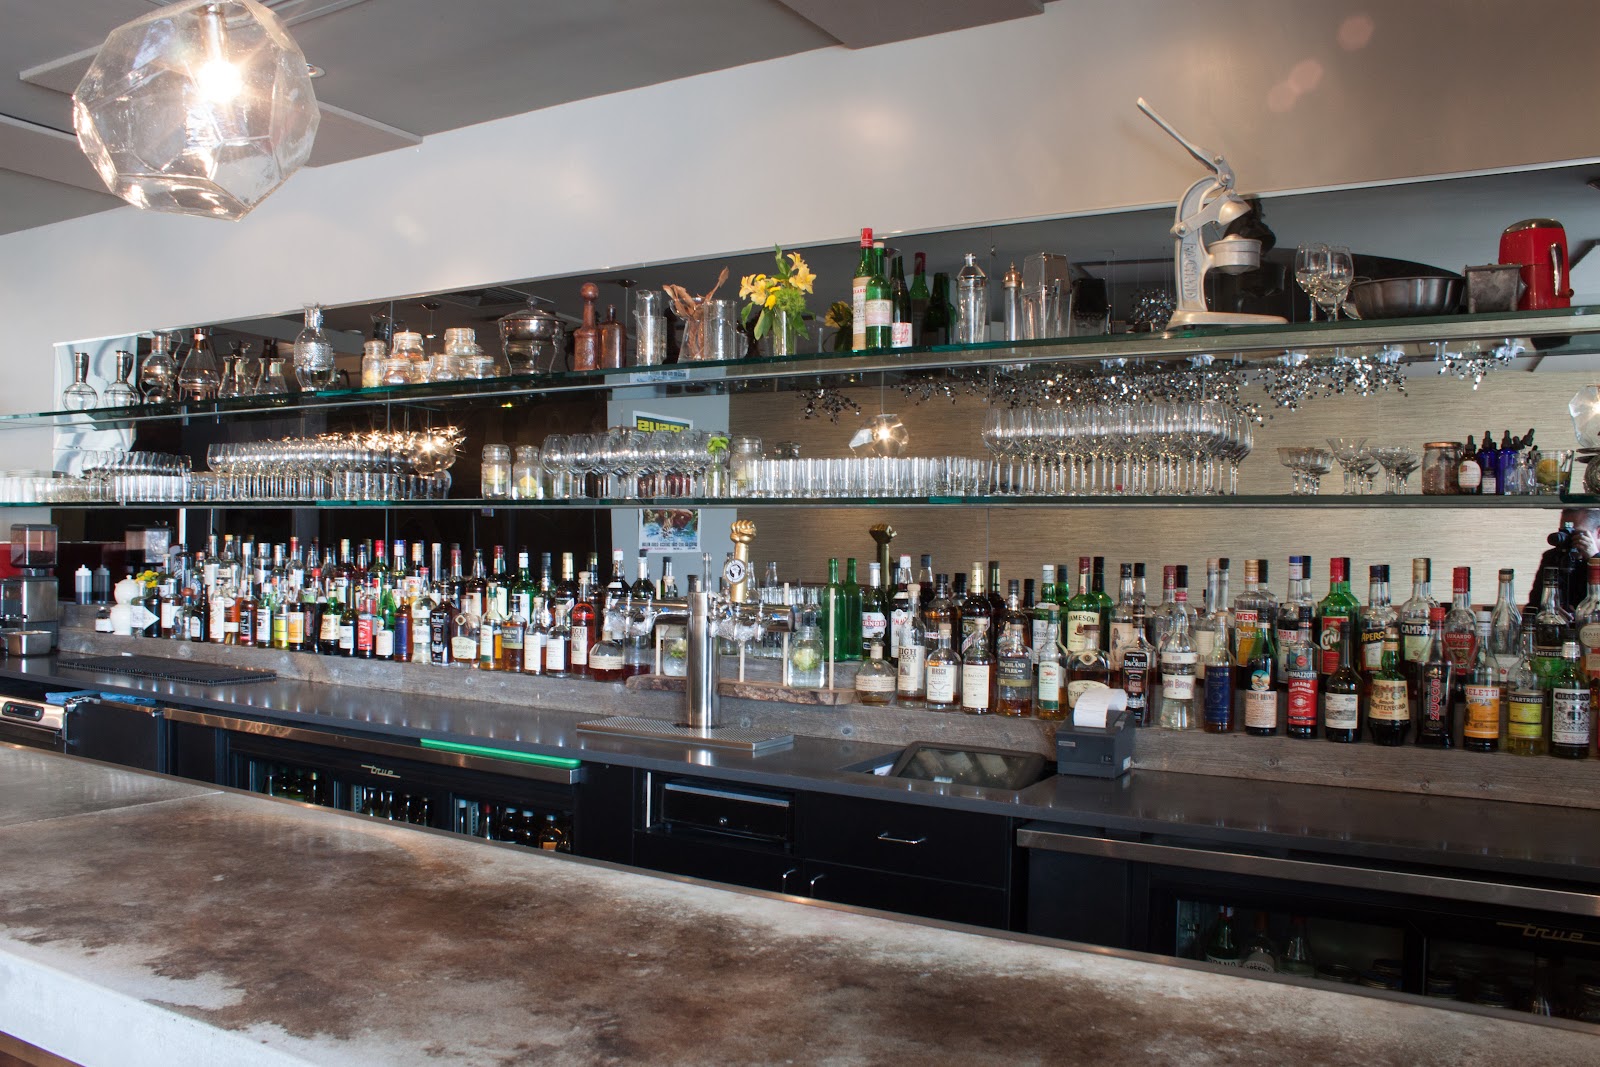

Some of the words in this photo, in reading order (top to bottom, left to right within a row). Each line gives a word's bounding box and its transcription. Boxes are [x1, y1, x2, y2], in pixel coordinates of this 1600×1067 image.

[1069, 614, 1096, 623] JAMESON
[1236, 613, 1258, 621] AVERN
[1401, 624, 1431, 635] CAMPA
[1321, 629, 1340, 651] CYN
[1361, 631, 1386, 642] APERO
[999, 661, 1026, 669] HIGHLAND
[1430, 678, 1440, 721] ZUCCA
[1509, 695, 1543, 704] CHARTREUSE
[1510, 922, 1592, 944] true
